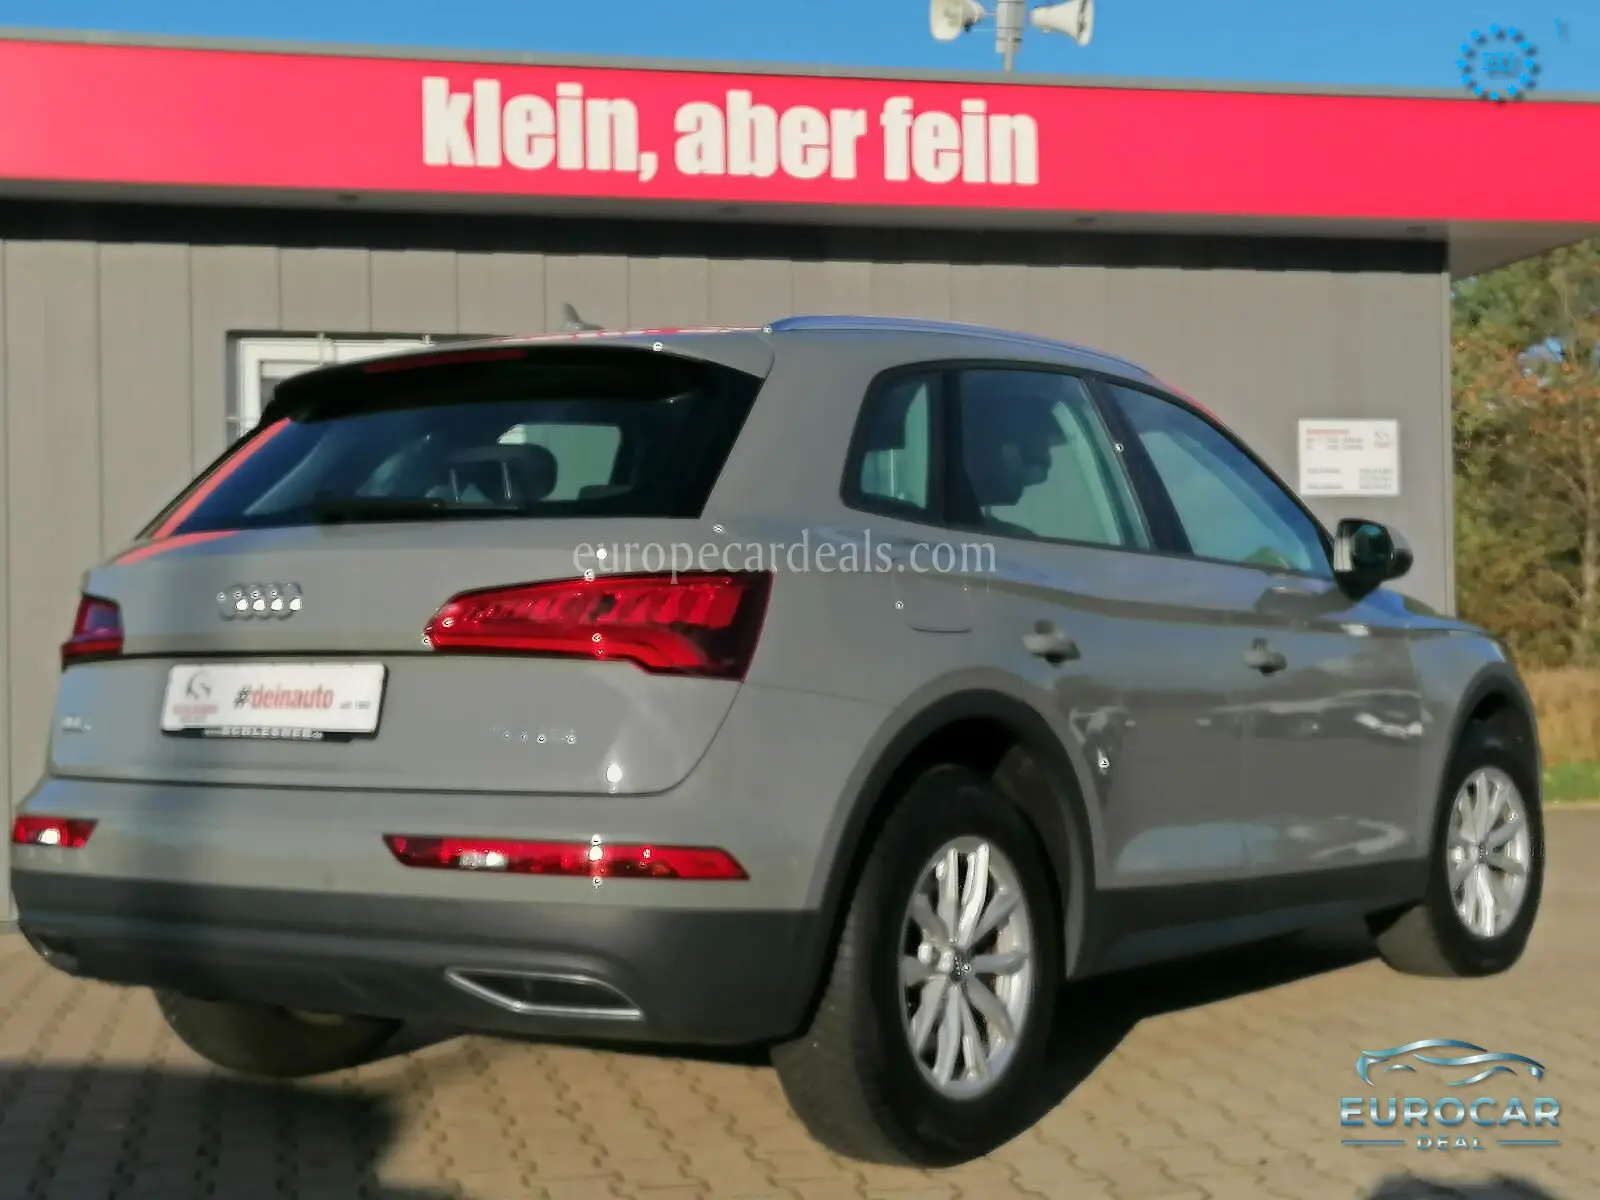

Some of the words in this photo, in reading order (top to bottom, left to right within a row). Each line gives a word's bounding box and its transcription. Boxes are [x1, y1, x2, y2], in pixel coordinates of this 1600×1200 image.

[421, 76, 657, 182] klein,
[674, 89, 866, 180] aber
[880, 96, 1039, 185] fein
[233, 684, 334, 709] #deinauto
